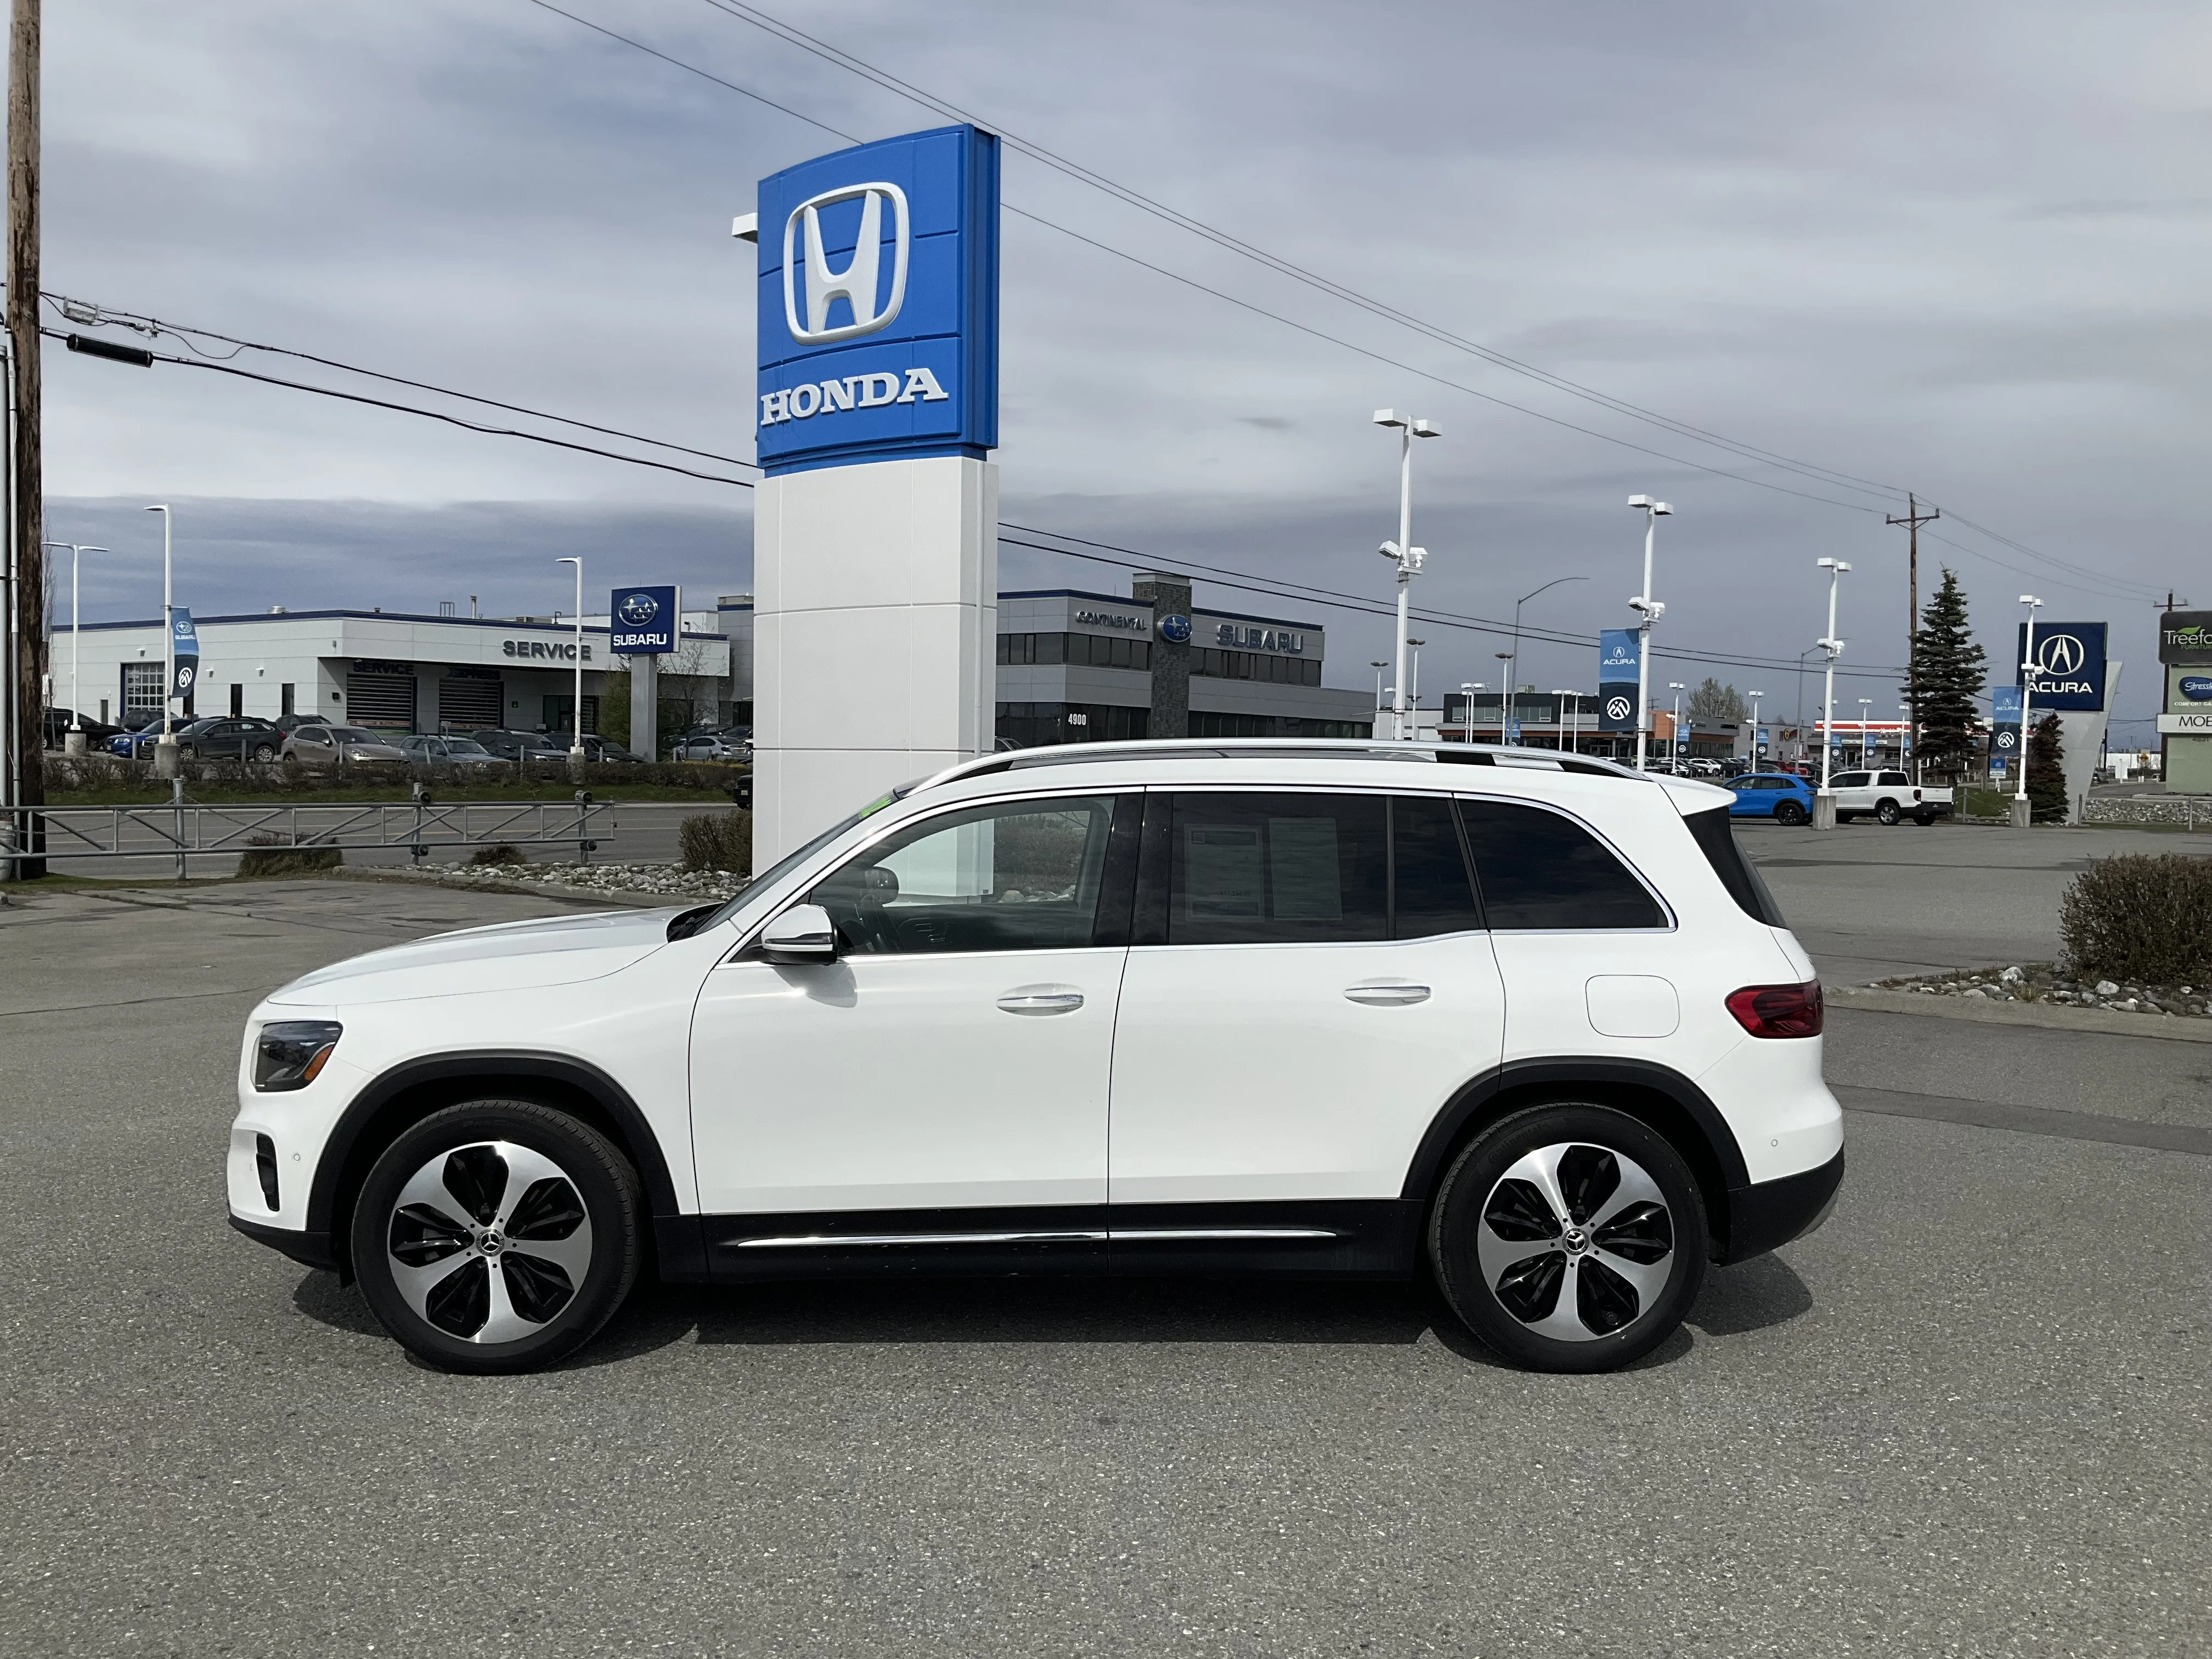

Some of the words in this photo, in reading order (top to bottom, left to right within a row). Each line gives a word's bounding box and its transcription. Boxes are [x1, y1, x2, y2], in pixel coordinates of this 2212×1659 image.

[760, 367, 949, 426] HONDA
[1077, 611, 1147, 630] CONTINENTAL
[613, 633, 667, 646] SUBARU
[1217, 624, 1304, 654] SUBARU
[503, 640, 592, 662] SERVICE
[2029, 681, 2093, 693] ACURA
[1068, 713, 1086, 726] 4900
